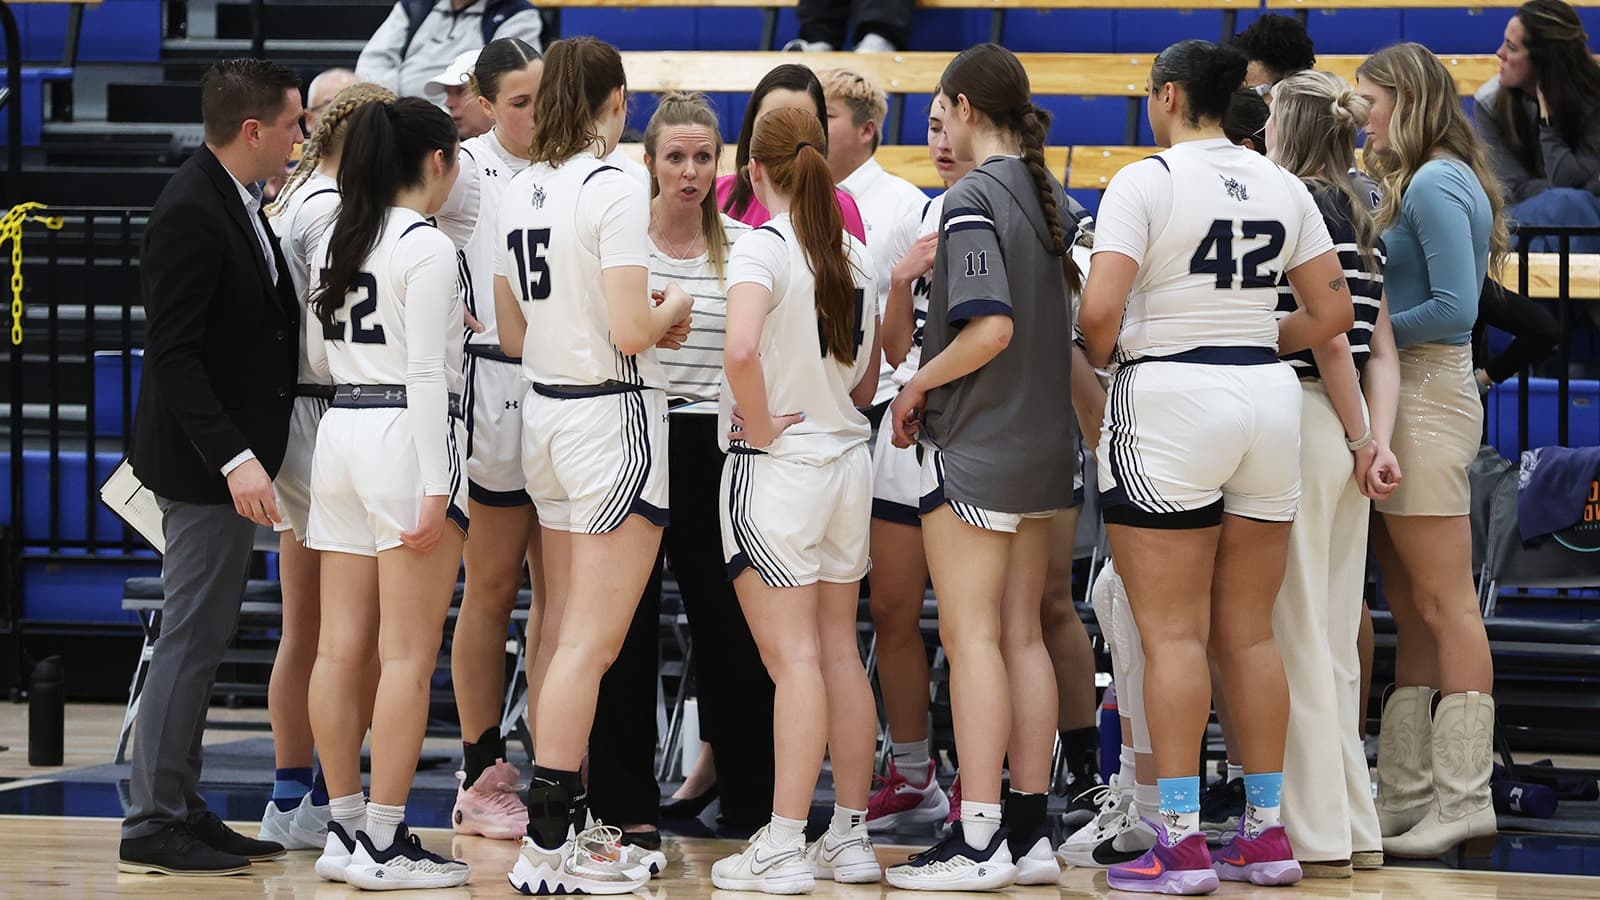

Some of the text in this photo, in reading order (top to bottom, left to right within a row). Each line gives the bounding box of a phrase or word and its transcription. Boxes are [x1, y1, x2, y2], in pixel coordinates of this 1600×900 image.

[507, 227, 552, 301] 15
[964, 250, 989, 277] 11
[1190, 219, 1286, 289] 42
